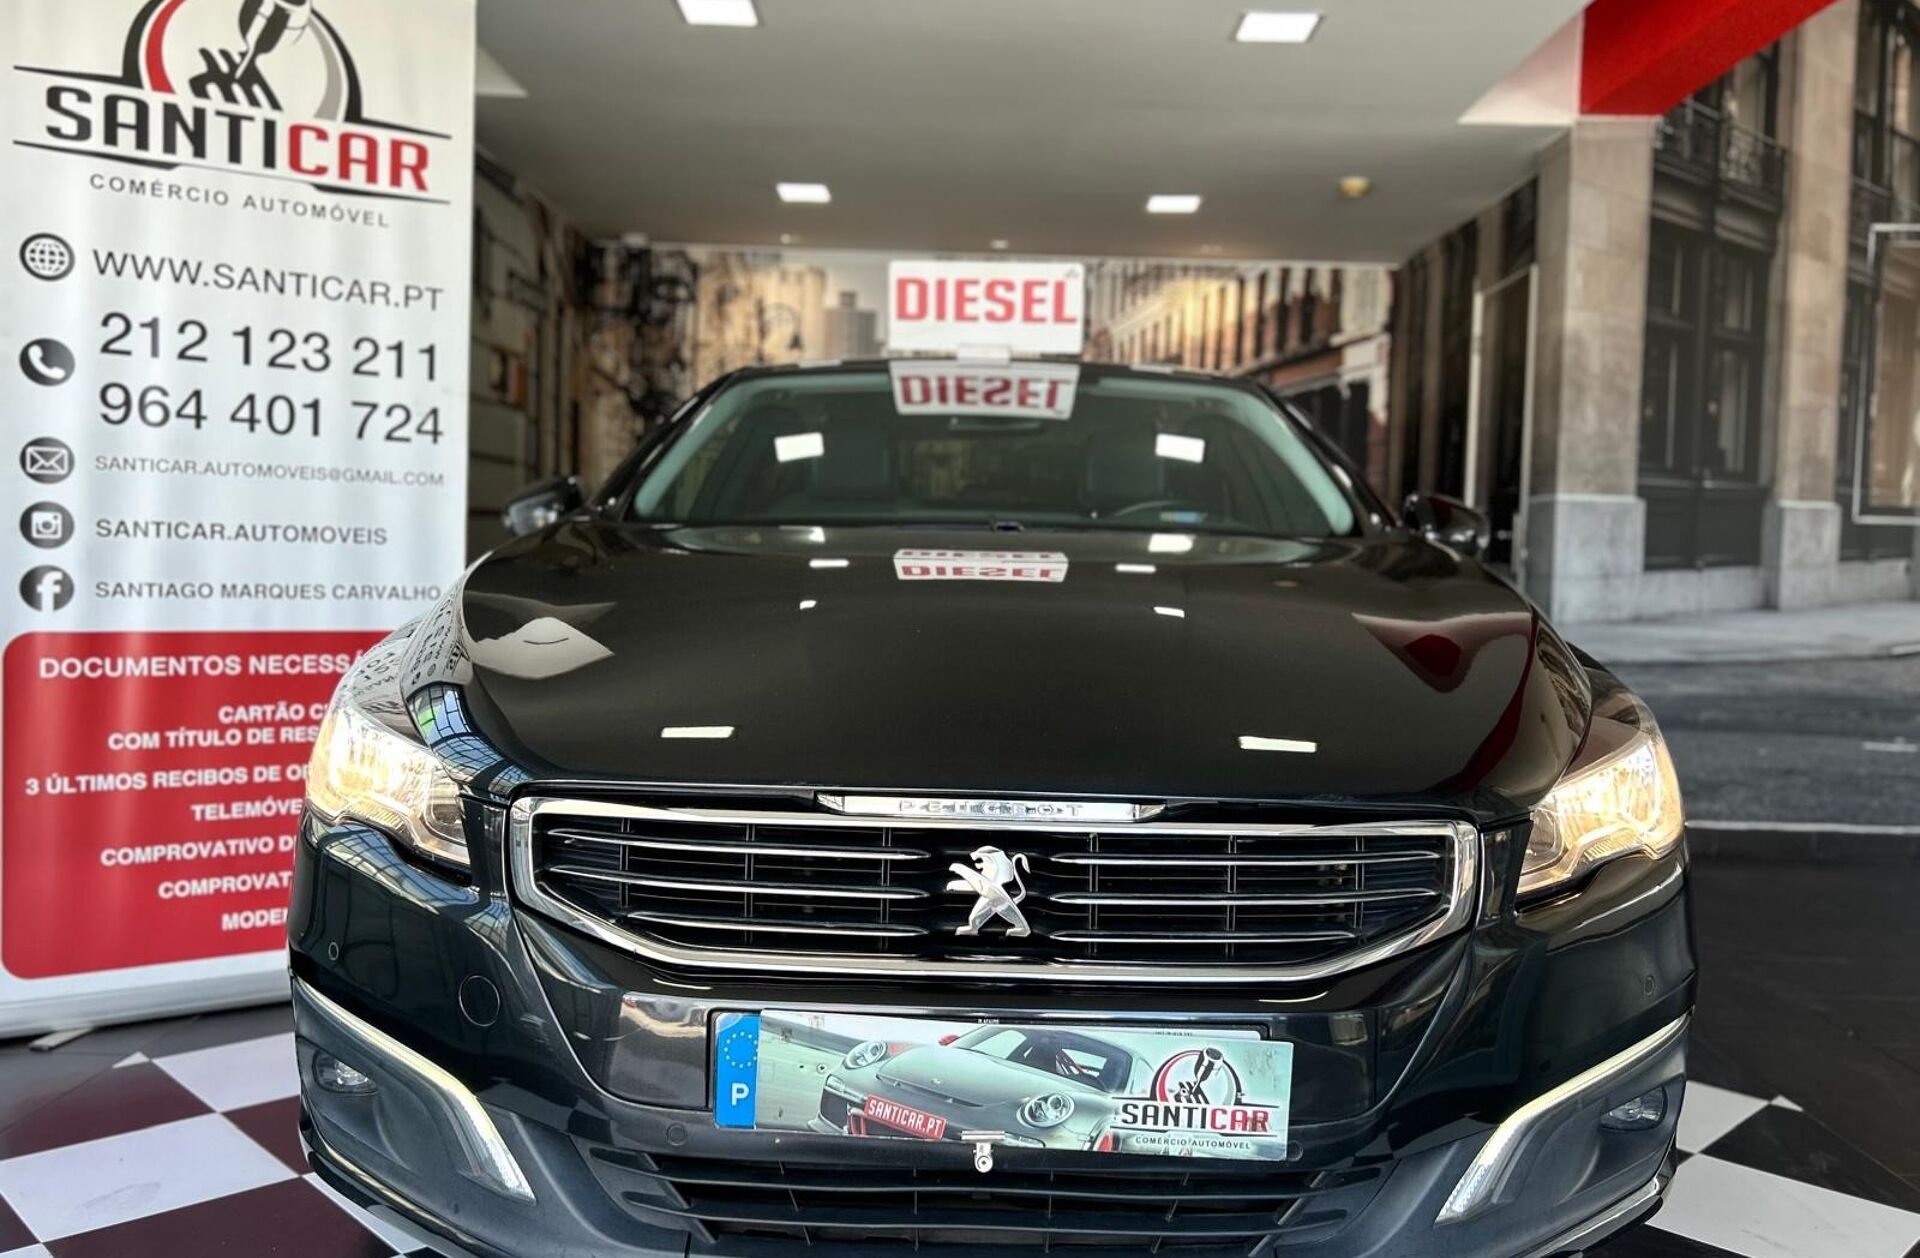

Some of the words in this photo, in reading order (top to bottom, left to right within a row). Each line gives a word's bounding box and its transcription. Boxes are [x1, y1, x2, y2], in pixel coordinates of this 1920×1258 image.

[46, 86, 429, 192] SANTICAR
[90, 173, 229, 206] COMÉRCIO
[243, 194, 390, 228] AUTOMÓVEL
[92, 249, 444, 311] WWW.SANTICAR.PT
[895, 278, 1077, 323] DIESEL
[100, 312, 208, 361] 212
[232, 326, 331, 371] 123
[352, 337, 436, 381] 211
[100, 383, 207, 429] 964
[230, 394, 320, 437] 401
[351, 401, 443, 444] 724
[95, 455, 444, 488] SANTICAR.AUTOMOVEIS@GMAIL.COM
[96, 519, 387, 545] SANTICAR.AUTOMOVEIS
[95, 582, 213, 599] SANTIAGO
[220, 583, 326, 600] MARQUES
[332, 584, 441, 600] CARVALHO
[39, 656, 241, 679] DOCUMENTOS
[219, 701, 304, 724] CARTÃO
[108, 733, 160, 750] COM
[168, 727, 241, 748] TÍTULO
[248, 727, 275, 745] DE
[26, 779, 39, 796] 3
[46, 773, 147, 795] ÚLTIMOS
[154, 767, 248, 788] RECIBOS
[253, 765, 281, 783] DE
[101, 836, 274, 866] COMPROVATIVO
[731, 1082, 749, 1106] P
[868, 1100, 942, 1137] SANTICAR.PT
[1121, 1103, 1269, 1132] SANTICAR
[1135, 1136, 1188, 1146] COMÉRCIO
[1192, 1139, 1251, 1150] AUTOMÓVEL
